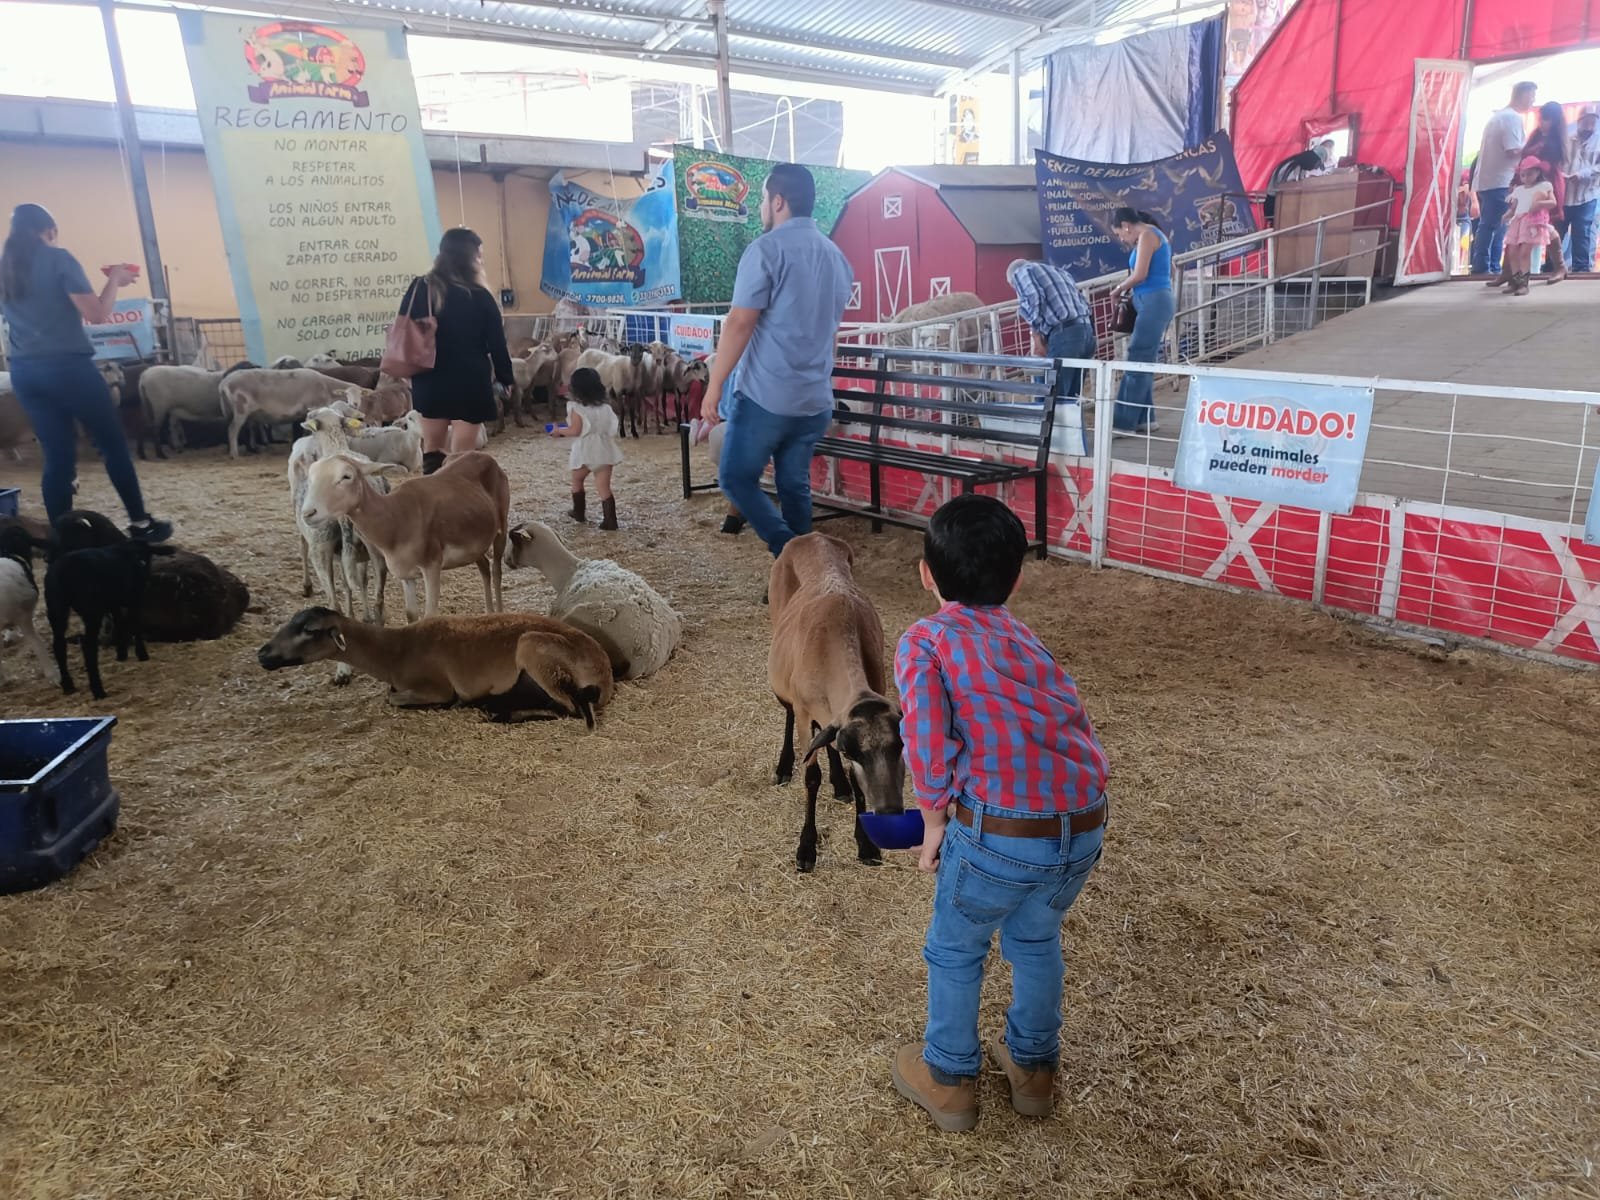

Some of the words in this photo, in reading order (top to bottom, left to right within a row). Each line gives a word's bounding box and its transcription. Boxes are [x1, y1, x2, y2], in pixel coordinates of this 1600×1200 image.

[214, 106, 408, 133] REGLAMENTO
[274, 138, 296, 152] NO
[304, 139, 368, 152] MONTAR
[293, 161, 356, 173] RESPETAR
[265, 176, 274, 186] A
[280, 175, 304, 186] LOS
[311, 175, 385, 187] ANIMALITOS
[269, 202, 293, 214] LOS
[300, 199, 339, 214] NIÑOS
[344, 201, 392, 213] ENTRAR
[269, 216, 296, 228] CON
[302, 215, 344, 227] ALGUN
[350, 214, 396, 226] ADULTO
[1050, 214, 1075, 224] BODAS
[1051, 224, 1093, 235] FUNERALES
[299, 239, 350, 252] ENTRAR
[355, 238, 379, 250] CON
[1052, 235, 1112, 248] GRADUACIONES
[286, 254, 338, 266] ZAPATO
[344, 251, 398, 263] CERRADO
[269, 281, 289, 292] NO
[295, 277, 348, 290] CORRER,
[354, 276, 371, 287] NO
[291, 293, 310, 304] NO
[277, 318, 296, 329] NO
[302, 314, 352, 327] CARGAR
[296, 329, 330, 342] SOLO
[335, 326, 361, 338] CON
[1198, 399, 1356, 440] ¡CUIDADO!
[1222, 440, 1246, 456] Los
[1251, 445, 1319, 465] animales
[1209, 458, 1267, 476] pueden
[1271, 466, 1329, 484] morder
